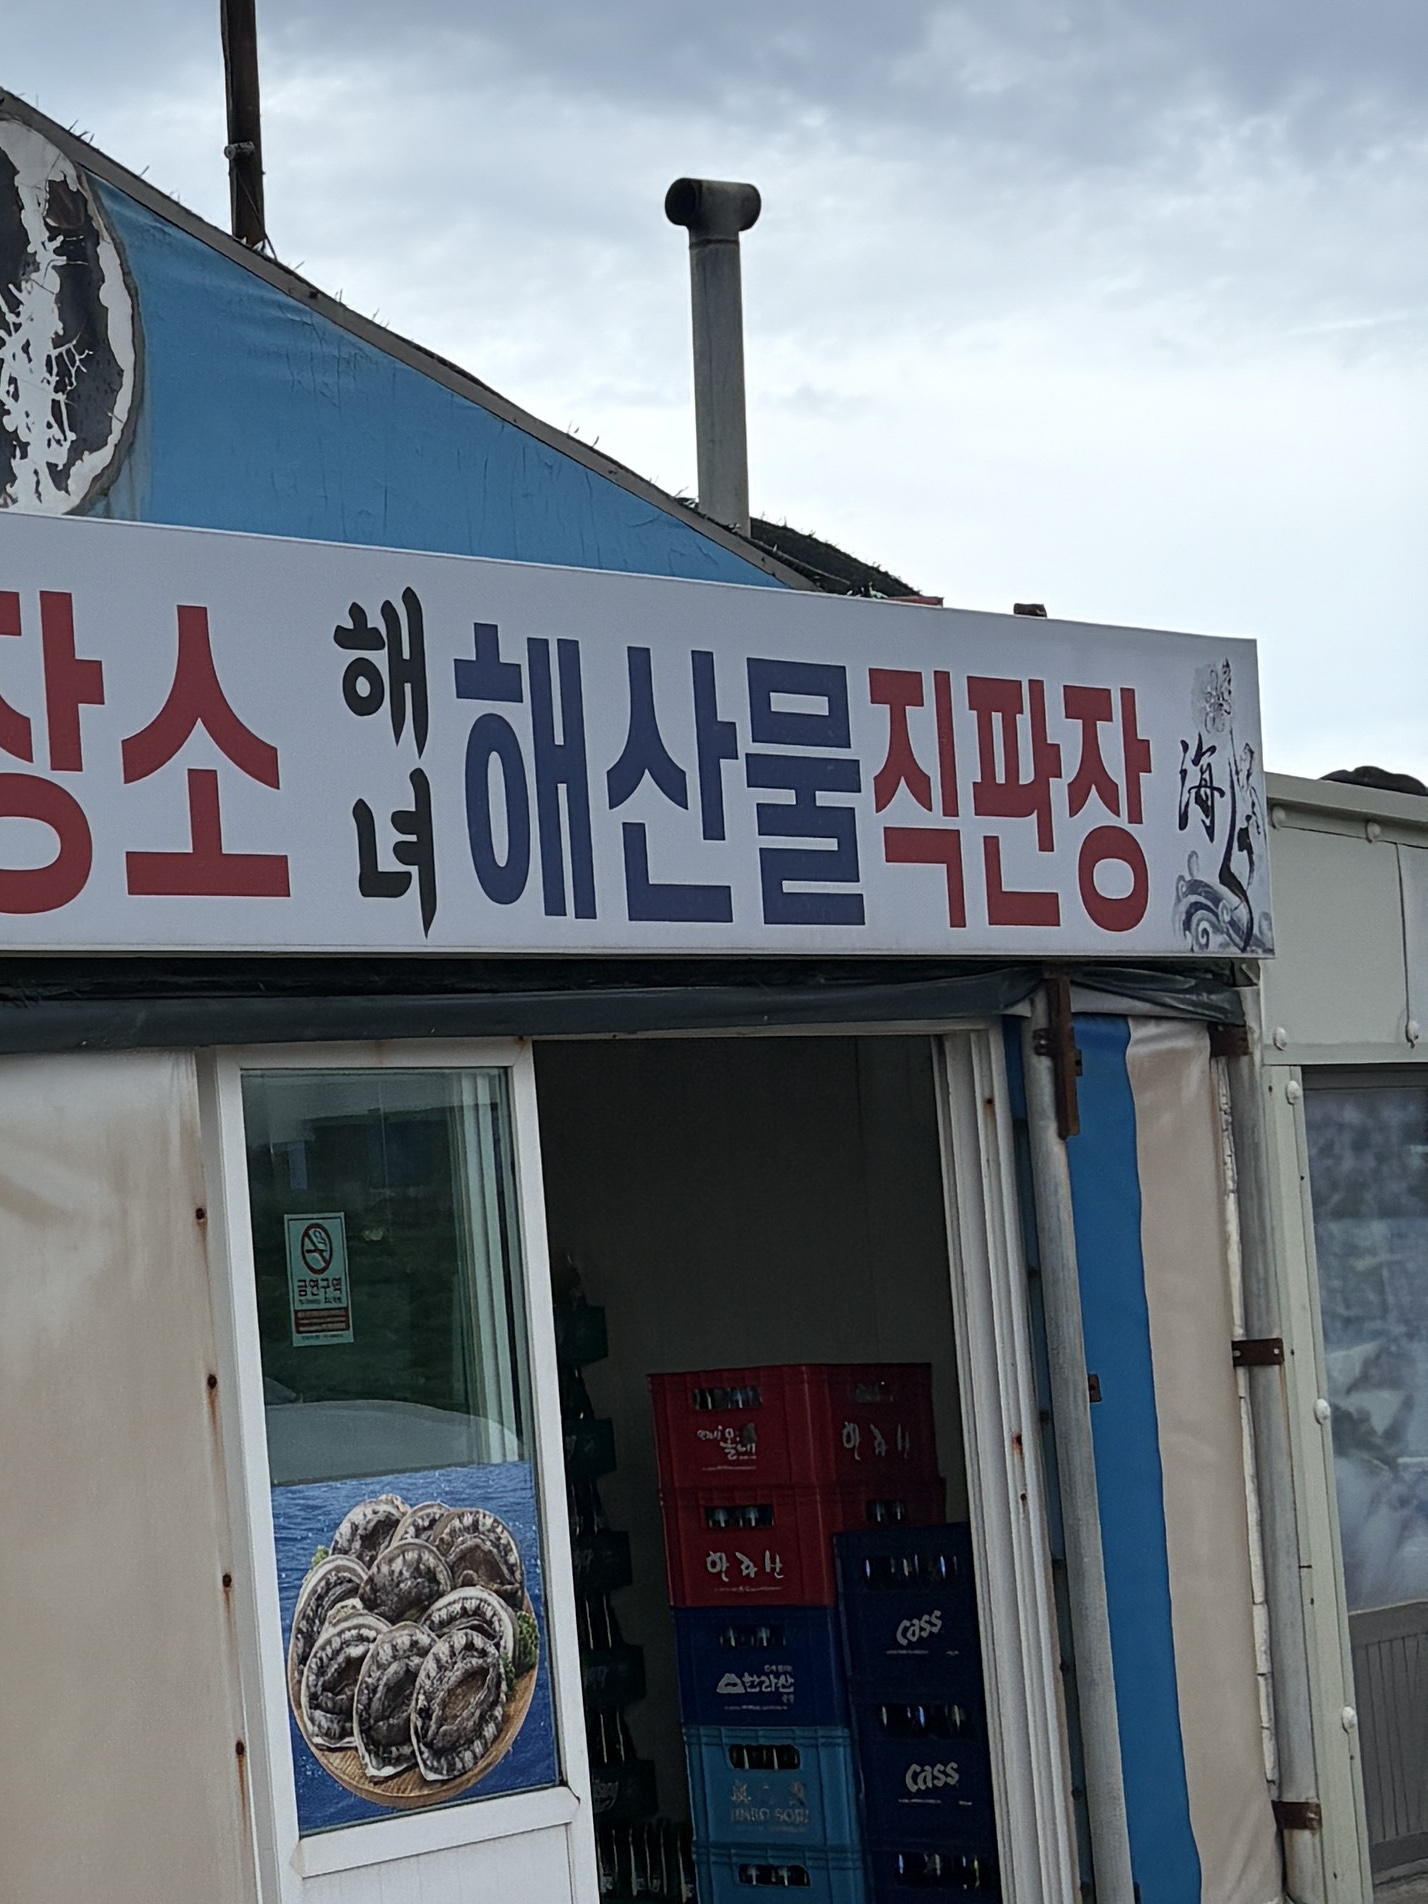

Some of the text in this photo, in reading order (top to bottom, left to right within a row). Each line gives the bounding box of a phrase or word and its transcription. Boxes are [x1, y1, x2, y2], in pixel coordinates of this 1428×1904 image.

[333, 585, 437, 938] 해녀
[895, 1609, 943, 1646] Cass
[904, 1760, 961, 1794] Cass
